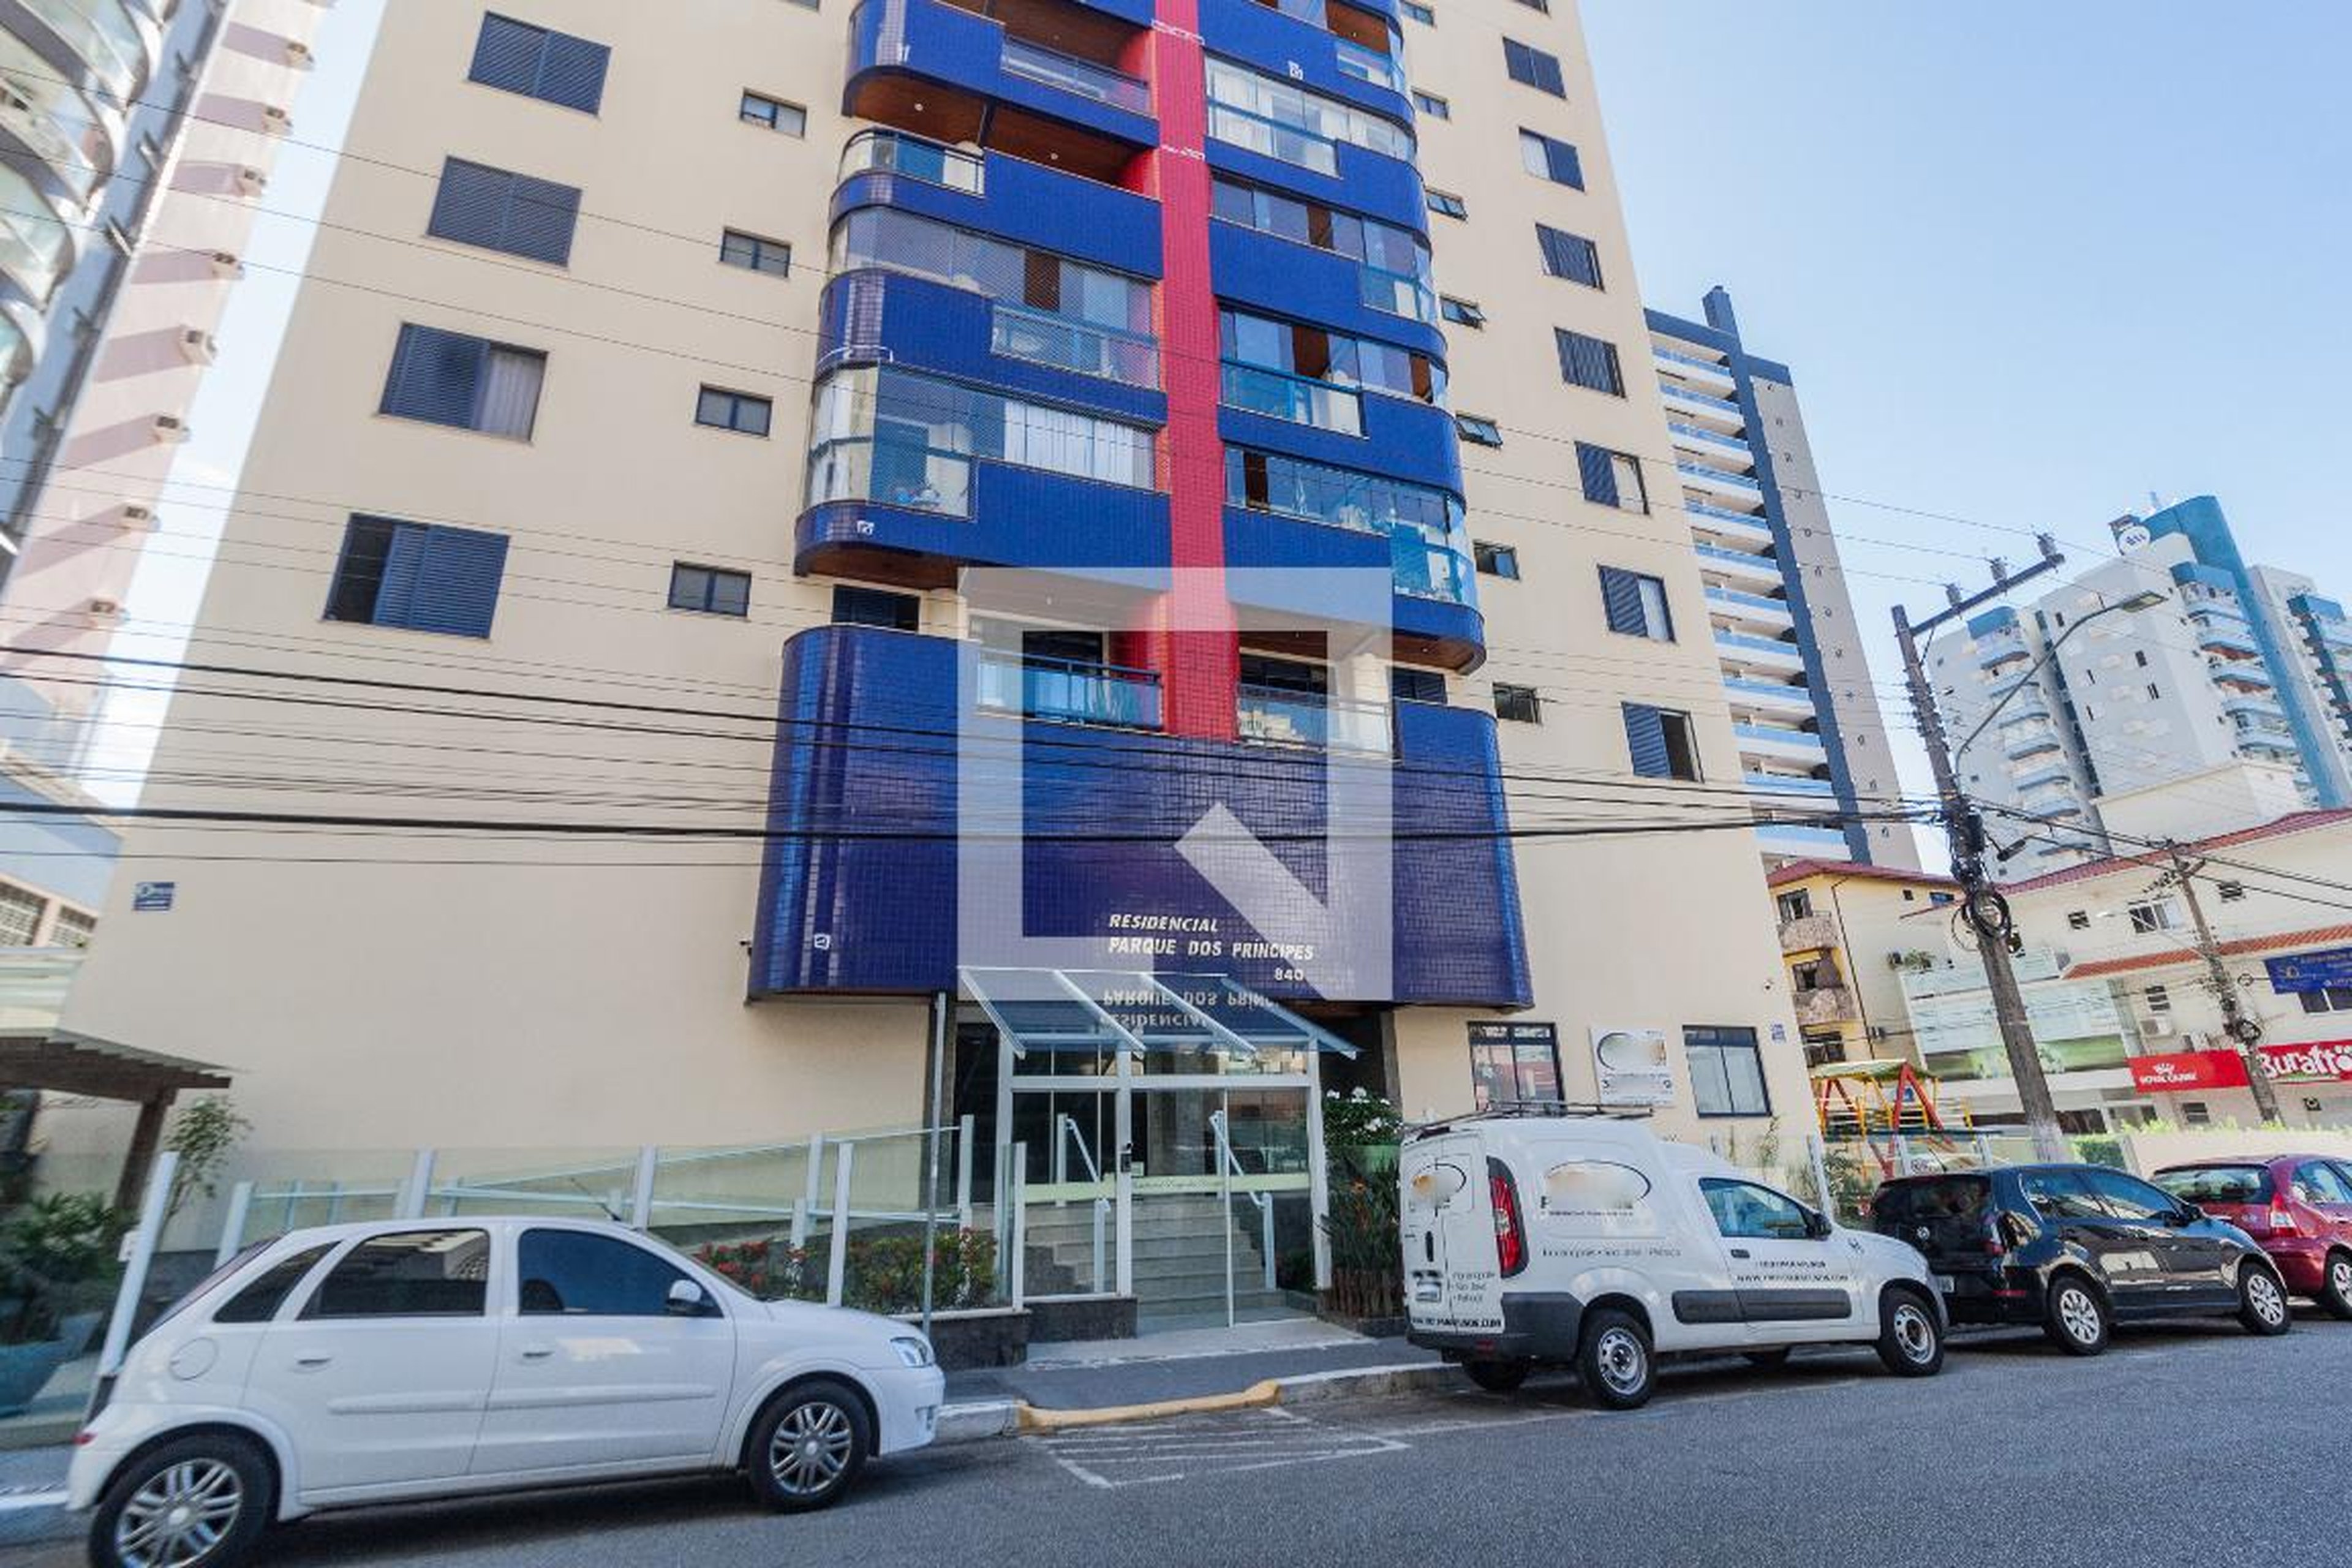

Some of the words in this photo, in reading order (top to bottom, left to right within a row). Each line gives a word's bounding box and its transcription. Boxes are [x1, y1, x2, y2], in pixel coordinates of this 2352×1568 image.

[1109, 914, 1218, 932] RESIDENCIAL
[1108, 937, 1177, 954] PARQUE
[1188, 941, 1222, 956] DOS
[1232, 938, 1314, 960] PRÍNCIPES
[1274, 968, 1305, 980] 840
